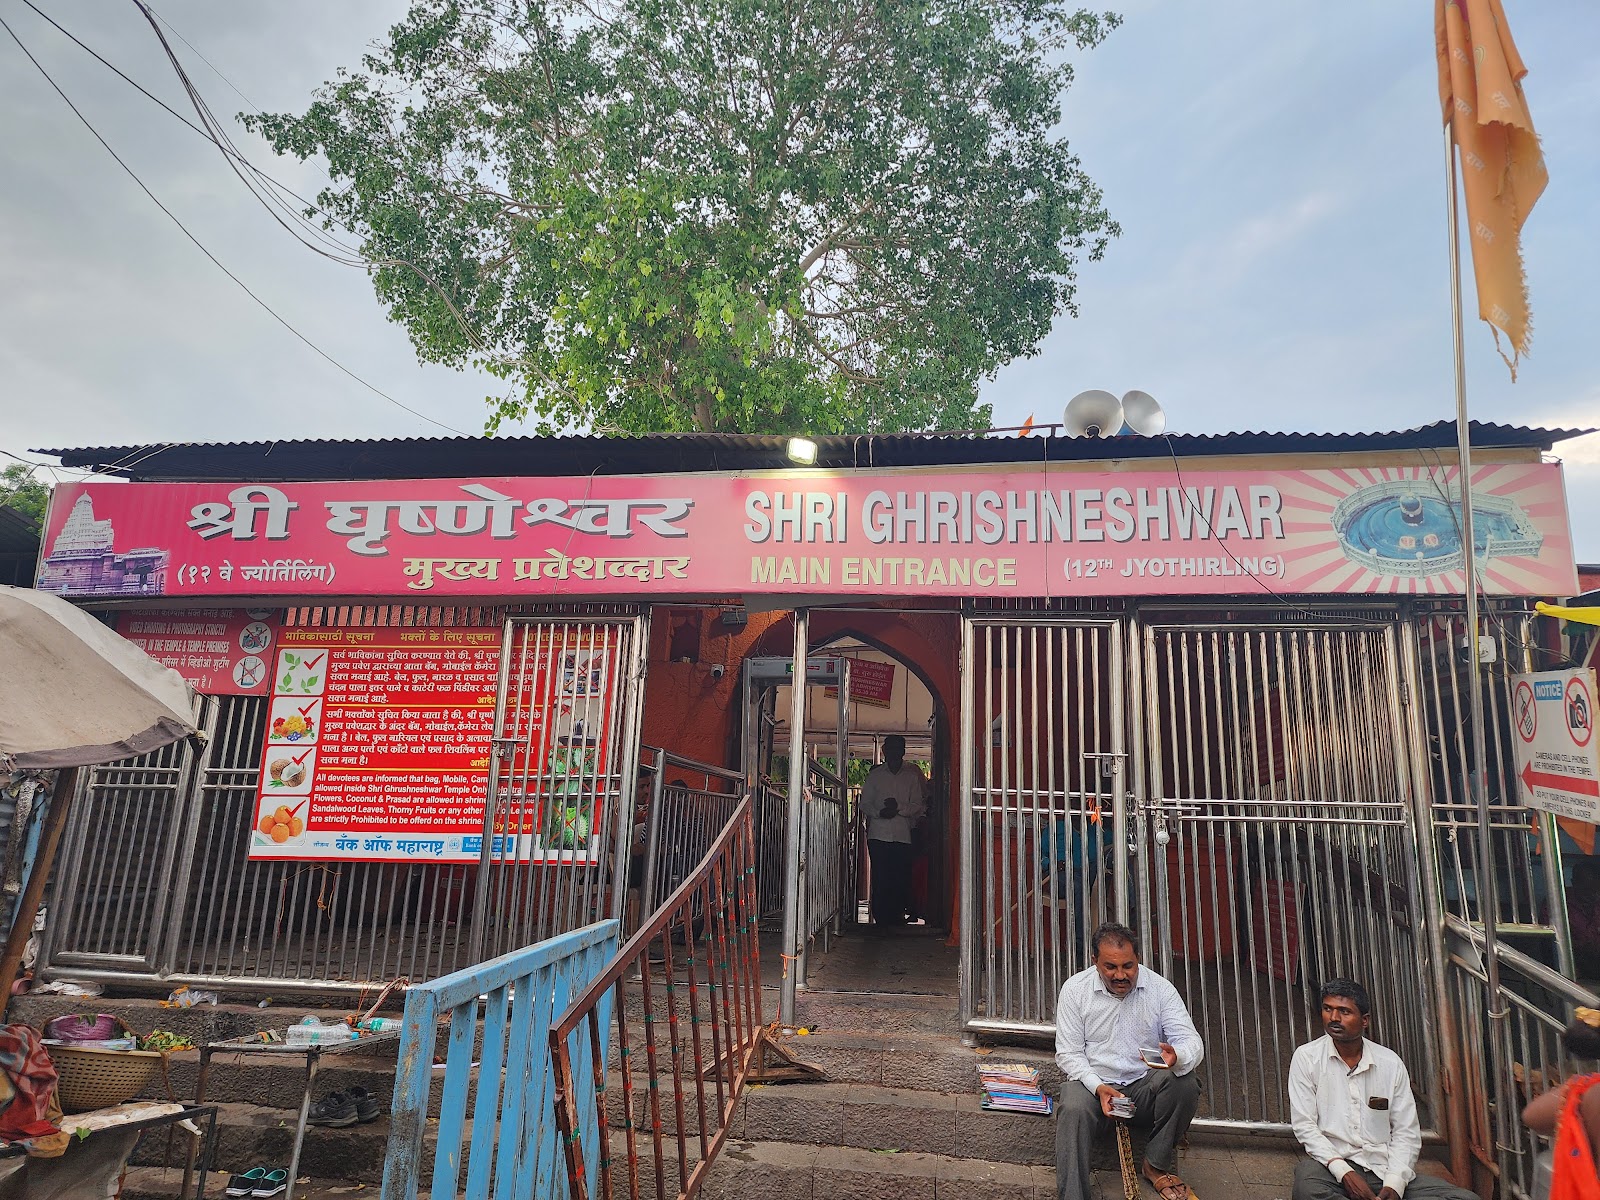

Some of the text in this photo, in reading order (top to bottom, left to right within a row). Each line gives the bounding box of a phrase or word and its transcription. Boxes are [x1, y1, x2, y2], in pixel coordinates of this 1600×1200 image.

[186, 484, 695, 555] श्री घृष्णेश्वर
[744, 484, 1285, 544] SHRI GHRISHNESHWAR
[177, 563, 211, 586] (१२
[219, 559, 236, 582] वे
[403, 557, 502, 589] मुख्य
[751, 556, 1018, 587] MAIN ENTRANCE
[1063, 554, 1286, 581] (12TH JYOTHIRLING)
[286, 628, 375, 644] भाविकांसाठी सूचना
[400, 630, 496, 645] भक्तों के लिए सूचना
[163, 639, 182, 652] TEMPLE
[187, 640, 207, 653] TEMPLE
[332, 649, 346, 659] सर्व
[410, 652, 442, 660] करण्यात
[474, 650, 484, 660] श्री
[331, 662, 350, 672] मुख्य
[352, 661, 370, 670] प्रवेश
[330, 673, 348, 681] सक्त
[351, 672, 371, 682] मनाई
[464, 674, 484, 682] प्रसाद
[329, 682, 346, 692] चंदन
[1536, 684, 1562, 698] NOTICE
[348, 693, 369, 703] मनाई
[402, 709, 420, 719] किया
[443, 710, 448, 720] है
[467, 710, 477, 719] श्री
[325, 722, 343, 732] मुख्य
[478, 746, 488, 754] पर
[328, 774, 360, 782] devotees
[375, 775, 407, 783] informed
[409, 775, 423, 783] that
[443, 775, 468, 784] Mobile,
[315, 784, 470, 794] allowed inside Shri Ghrushneshwar Temple
[314, 794, 344, 803] Flowers,
[346, 795, 376, 803] Coconut
[378, 795, 384, 803] &
[386, 795, 410, 803] Prasad
[426, 796, 454, 804] allowed
[456, 796, 463, 804] in
[312, 804, 357, 813] Sandalwood
[358, 805, 386, 814] Leaves,
[388, 806, 413, 815] Thorny
[415, 806, 436, 814] Fruits
[448, 808, 462, 816] any
[464, 806, 482, 814] other
[324, 815, 349, 824] strictly
[351, 816, 388, 824] Prohibited
[390, 816, 397, 824] to
[399, 816, 408, 824] be
[410, 816, 432, 824] offerd
[458, 817, 484, 825] shrine.
[336, 833, 444, 856] बँक ऑफ महाराष्ट्र
